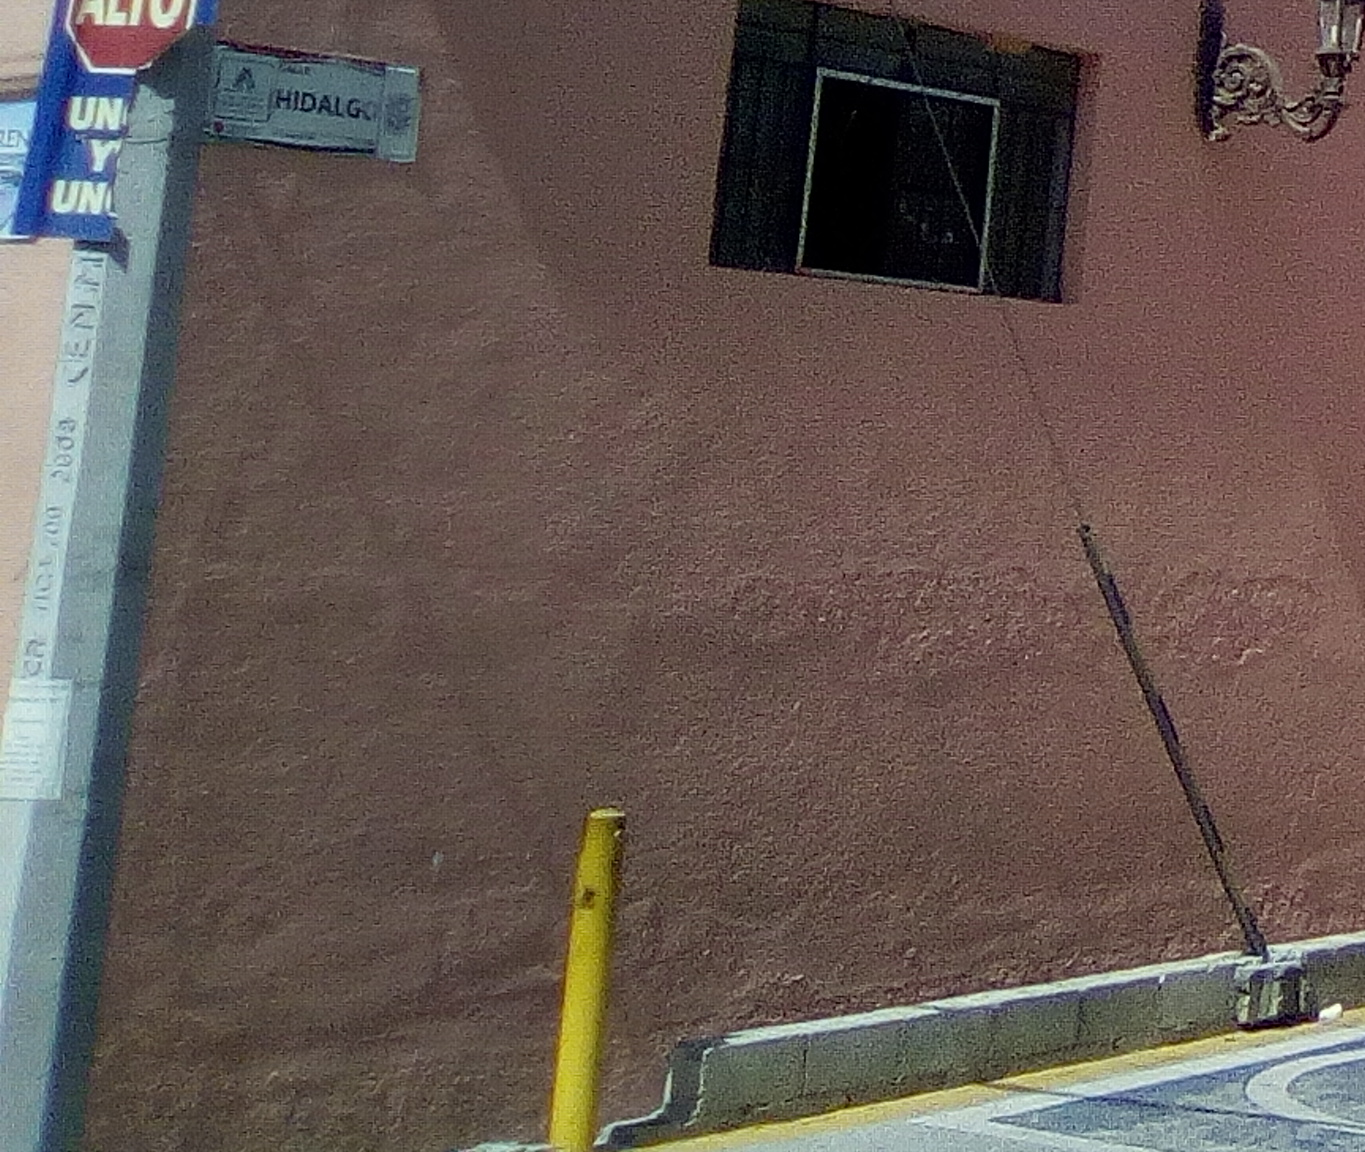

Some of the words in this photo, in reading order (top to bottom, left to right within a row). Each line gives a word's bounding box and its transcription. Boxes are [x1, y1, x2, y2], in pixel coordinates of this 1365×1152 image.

[68, 97, 127, 130] UN
[91, 139, 122, 172] Y
[52, 180, 112, 215] UN
